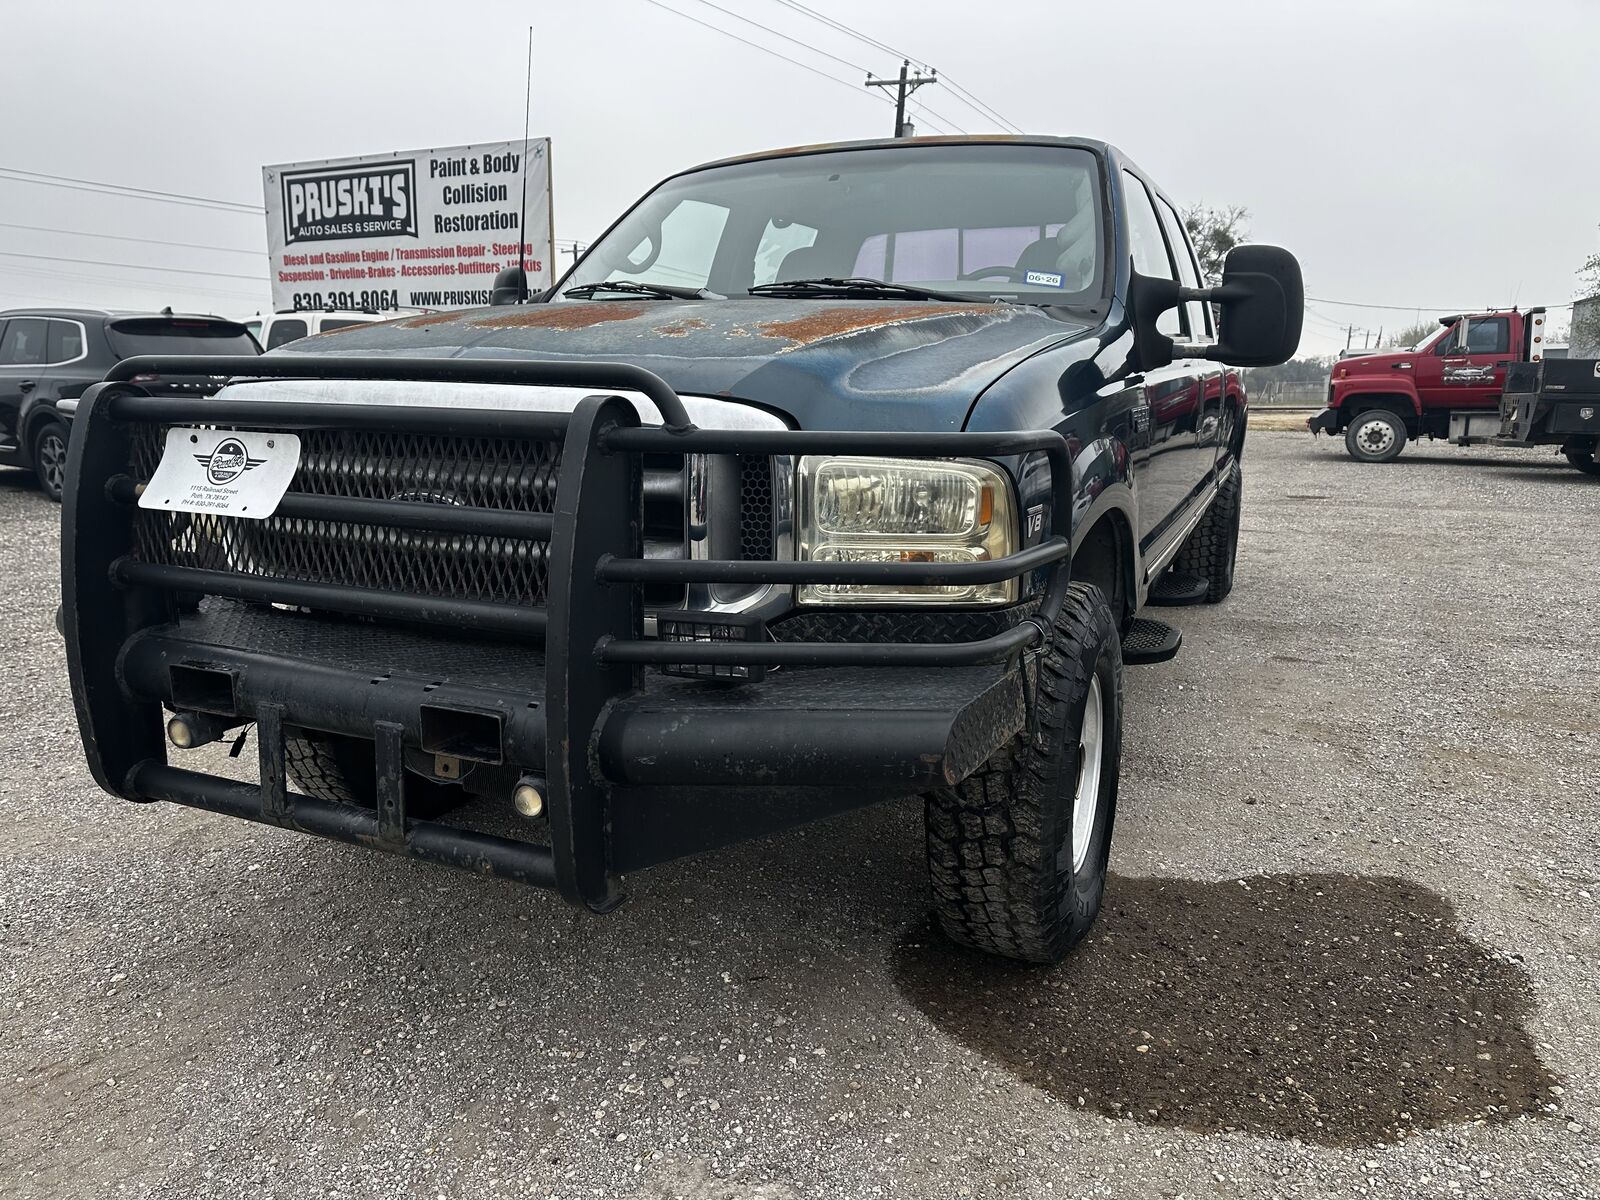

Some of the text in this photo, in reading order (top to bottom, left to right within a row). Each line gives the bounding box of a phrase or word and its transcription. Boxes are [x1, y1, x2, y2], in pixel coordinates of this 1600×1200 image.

[430, 152, 520, 178] Paint & Body
[290, 173, 407, 228] PRUSKI'S
[443, 182, 507, 205] Collision
[298, 219, 402, 236] AUTO SALES & SERVICE
[434, 210, 518, 233] Restoration
[283, 253, 308, 266] Diesel
[309, 252, 324, 265] and
[325, 250, 360, 264] Gasoline
[360, 249, 389, 263] Engine
[390, 248, 394, 261] /
[395, 246, 455, 260] Transmission
[456, 244, 486, 258] Repair
[278, 270, 325, 283] Suspension
[329, 266, 396, 280] Driveline-Brakes
[401, 261, 500, 277] Accessories-Outfitters
[524, 259, 542, 273] Kits
[293, 289, 399, 311] 830-391-8064
[223, 487, 239, 495] Street
[1027, 513, 1042, 538] V8
